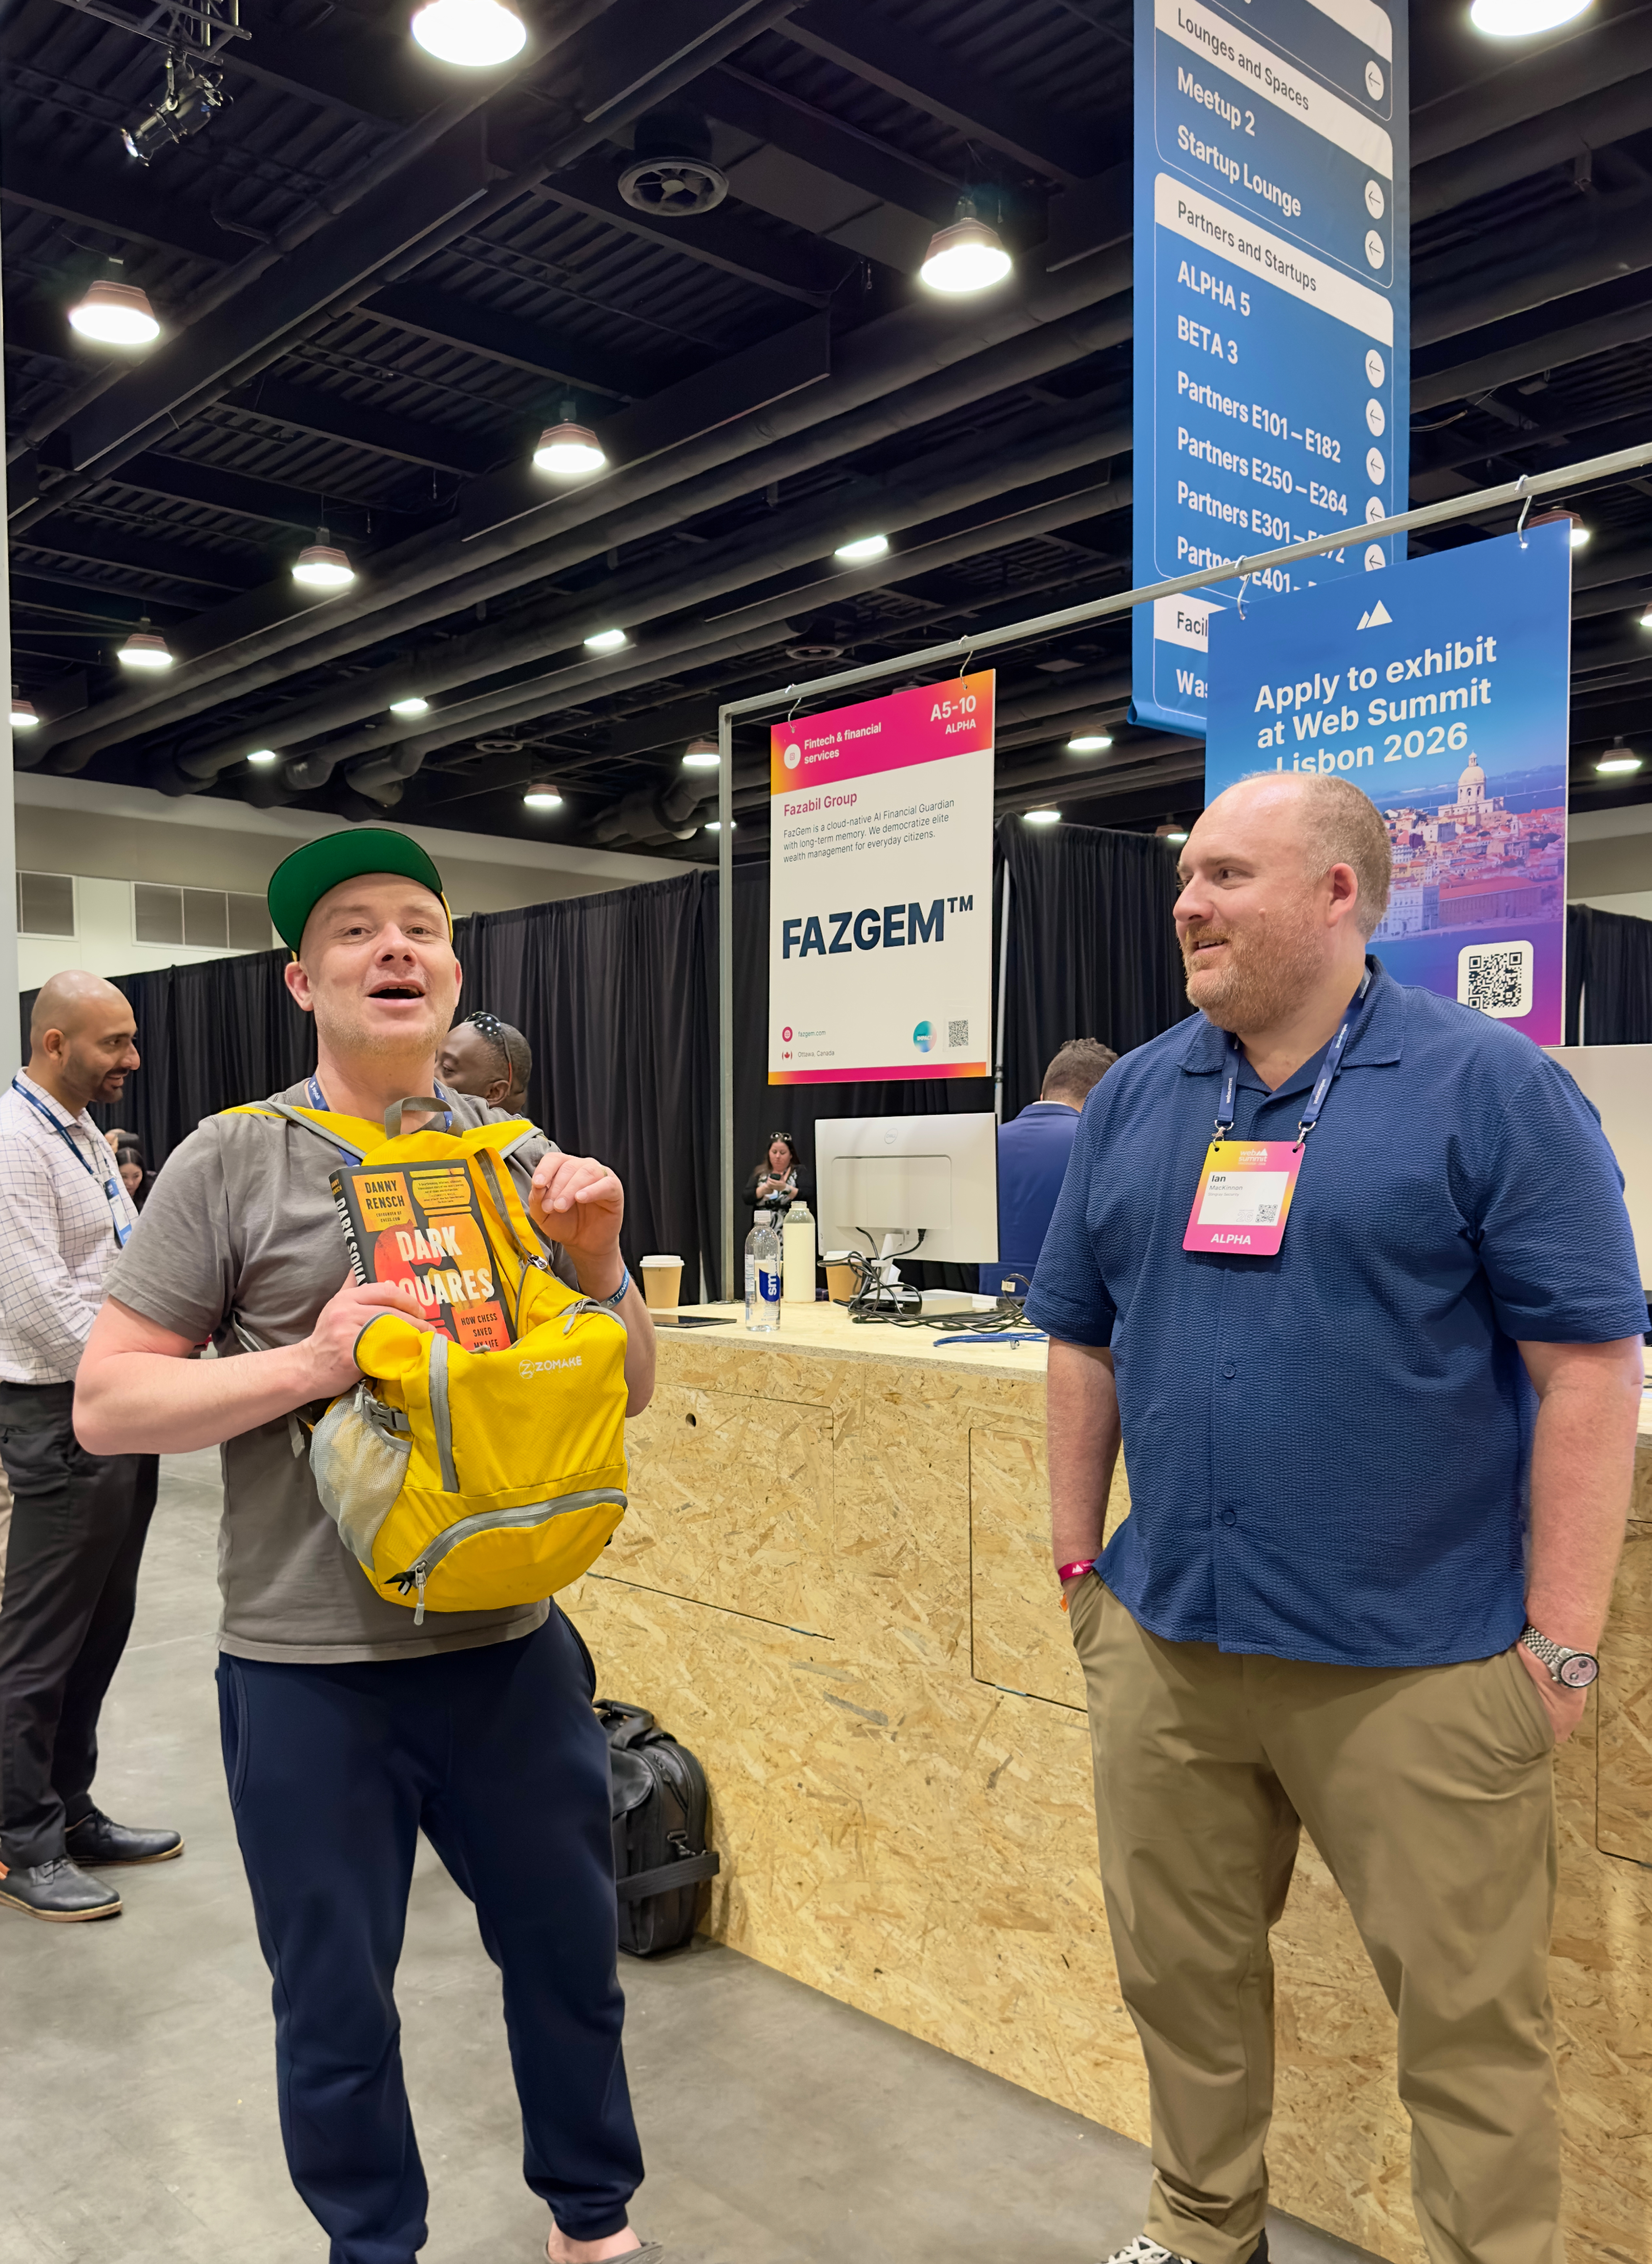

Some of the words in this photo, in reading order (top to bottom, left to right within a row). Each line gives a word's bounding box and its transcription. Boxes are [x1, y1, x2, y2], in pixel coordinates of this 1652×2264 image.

[1178, 7, 1235, 62] Lounges
[1238, 53, 1261, 80] and
[1265, 67, 1309, 111] Spaces
[1178, 66, 1241, 130] Meetup
[1245, 111, 1255, 137] 2
[1178, 125, 1240, 184] Startup
[1244, 162, 1301, 217] Lounge
[1178, 200, 1235, 247] Partners
[1238, 242, 1261, 262] and
[1265, 250, 1317, 292] Startups
[1178, 260, 1236, 310] ALPHA
[1241, 294, 1250, 316] 5
[1178, 315, 1223, 359] BETA
[1228, 340, 1238, 364] 3
[1178, 371, 1248, 424] Partners
[1252, 404, 1288, 440] E101
[1306, 428, 1341, 463] E182
[1178, 427, 1248, 477] Partners
[1252, 459, 1292, 494] E250
[1310, 482, 1348, 516] E264
[1178, 481, 1248, 529] Partners
[1252, 509, 1290, 543] E301
[1178, 536, 1247, 581] Partn
[1252, 568, 1290, 593] E401
[1254, 673, 1340, 714] Apply
[1348, 667, 1377, 691] to
[1386, 636, 1497, 683] exhibit
[930, 695, 977, 721] A5-10
[945, 719, 976, 735] ALPHA
[1257, 722, 1285, 748] at
[1293, 706, 1359, 742] Web
[1367, 678, 1492, 726] Summit
[804, 734, 834, 750] Fintech
[837, 732, 842, 742] &
[844, 722, 881, 741] financial
[1384, 722, 1468, 764] 2026
[804, 748, 839, 764] services
[784, 798, 821, 816] Fazabil
[824, 792, 857, 808] Group
[784, 827, 811, 838] FazGem
[813, 825, 818, 833] is
[827, 815, 872, 830] cloud-native
[874, 812, 881, 821] AI
[883, 805, 917, 820] Financial
[919, 800, 954, 813] Guardian
[784, 841, 798, 851] with
[800, 836, 833, 848] long-term
[836, 829, 866, 841] memory.
[869, 826, 880, 835] We
[883, 817, 930, 833] democratize
[932, 813, 949, 824] elite
[784, 852, 805, 863] wealth
[808, 844, 853, 858] management
[855, 842, 865, 851] for
[867, 836, 902, 848] everyday
[904, 831, 935, 842] citizens.
[365, 1180, 397, 1193] DANNY
[366, 1195, 405, 1209] RENSCH
[337, 1197, 355, 1243] DARK
[1211, 1233, 1251, 1245] ALPHA
[395, 1226, 462, 1261] DARK
[398, 1268, 495, 1306] QUARES
[461, 1316, 475, 1326] HOW
[477, 1313, 498, 1323] CHESS
[473, 1327, 492, 1337] SAVED
[535, 1356, 582, 1372] ZOMAKE
